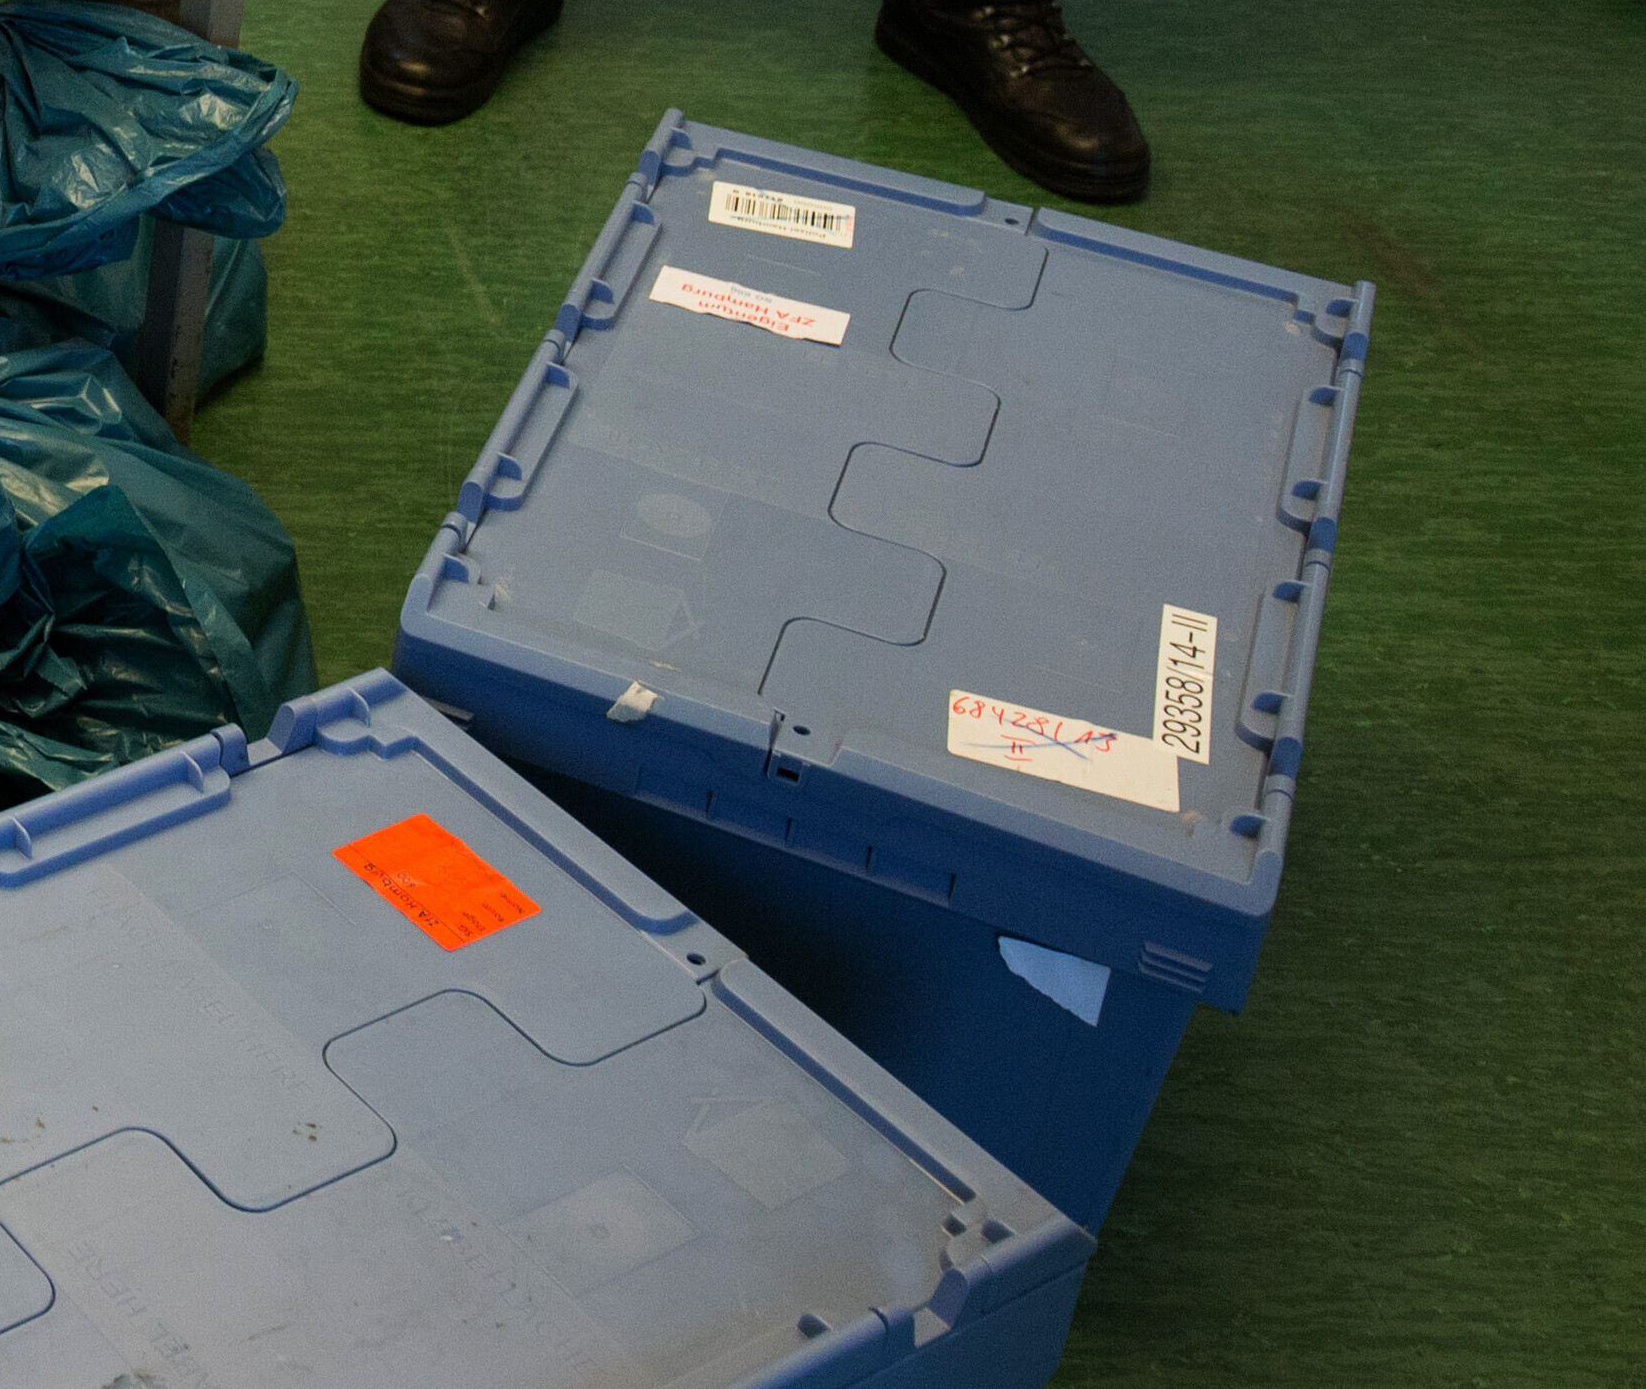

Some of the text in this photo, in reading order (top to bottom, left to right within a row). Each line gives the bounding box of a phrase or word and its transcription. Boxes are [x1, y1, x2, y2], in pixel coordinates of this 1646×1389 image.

[681, 283, 817, 328] ZFA Hamburg
[698, 300, 790, 332] Eigentum
[1161, 612, 1209, 754] 29358/14-II
[363, 862, 416, 910] Hamburg
